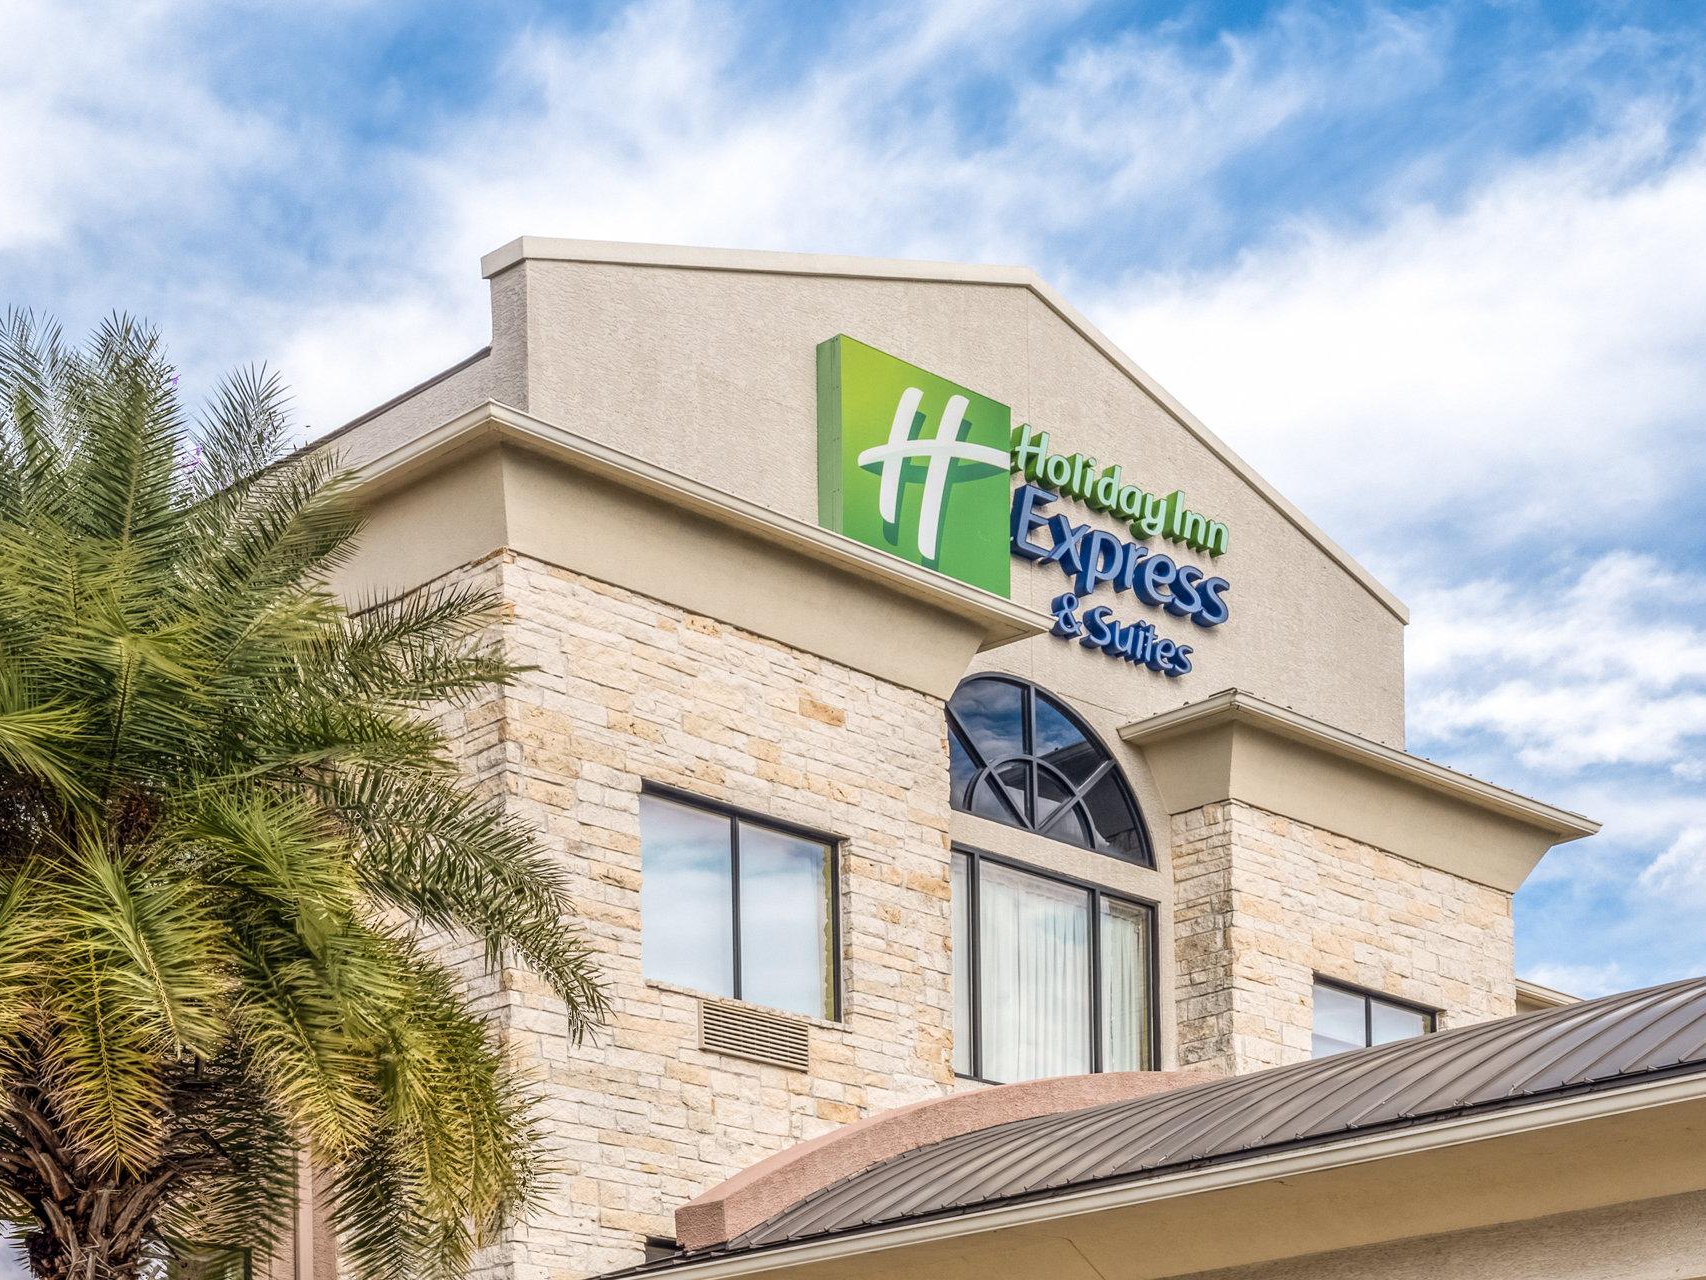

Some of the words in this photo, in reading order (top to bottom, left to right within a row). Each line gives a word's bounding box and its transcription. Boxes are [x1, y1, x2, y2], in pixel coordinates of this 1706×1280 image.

[1010, 484, 1230, 627] Express
[1011, 423, 1167, 540] Holiday
[1164, 490, 1229, 558] Inn
[1049, 592, 1082, 639] &
[1079, 606, 1194, 677] Suites
